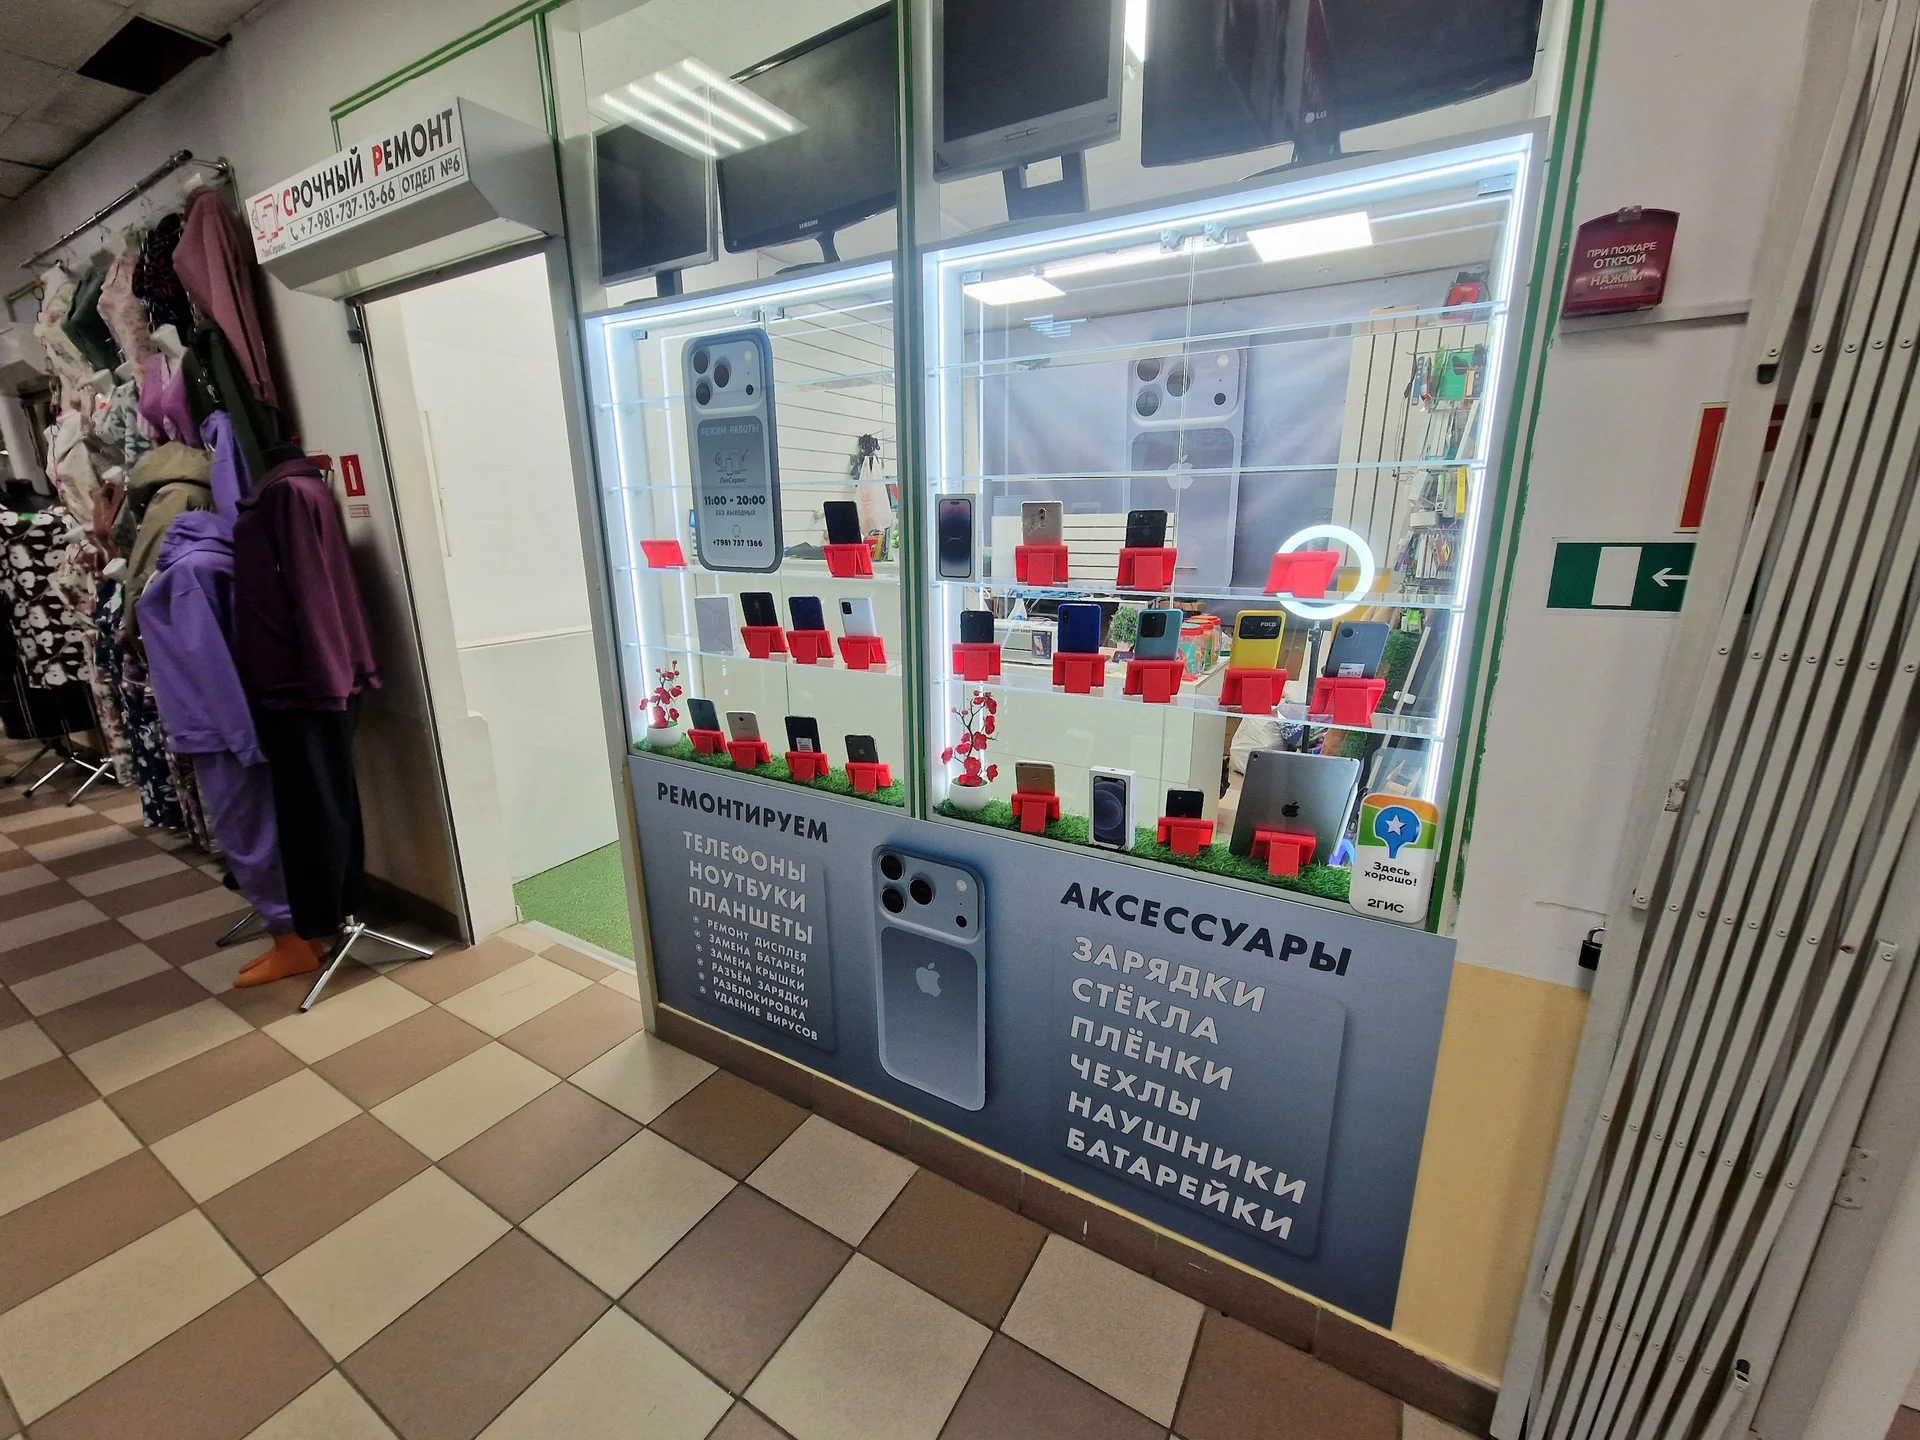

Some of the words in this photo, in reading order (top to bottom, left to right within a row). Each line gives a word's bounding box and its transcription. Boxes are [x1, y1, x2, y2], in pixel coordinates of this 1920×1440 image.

[282, 146, 364, 216] СРОЧНЫЙ
[371, 108, 453, 177] РЕМОНТ
[401, 165, 435, 194] ОТДЕЛ
[440, 154, 460, 178] №6
[1587, 249, 1608, 258] ПРИ
[1610, 241, 1658, 255] ПОЖАРЕ
[1593, 252, 1647, 269] ОТКРОЙ
[1590, 269, 1646, 286] НАЖМИ
[700, 426, 727, 436] РЕЖИМ
[729, 423, 759, 435] РАБОТЫ
[704, 495, 727, 506] 11:00
[736, 495, 766, 506] 20:00
[726, 509, 756, 517] ВЫХОДНЫХ
[712, 539, 731, 547] +7981
[657, 782, 828, 843] РЕМОНТИРУЕМ
[682, 830, 806, 883] ТЕЛЕФОНЫ
[1364, 870, 1418, 887] хорошо!
[1373, 861, 1411, 876] Здесь
[689, 860, 806, 913] НОУТБУКИ
[1367, 898, 1405, 914] 2ГИС
[688, 886, 813, 945] ПЛАНШЕТЫ
[1060, 882, 1352, 977] АКСЕССУАРЫ
[707, 919, 749, 942] РЕМОНТ
[754, 936, 807, 963] ДИСПЛЕЯ
[709, 933, 751, 957] ЗАМЕНА
[757, 951, 805, 977] БАТАРЕИ
[710, 948, 752, 972] ЗАМЕНА
[755, 965, 805, 992] КРЫШКИ
[712, 962, 752, 985] РАЗЪЁМ
[757, 980, 809, 1009] ЗАРЯДКИ
[1071, 936, 1266, 1013] ЗАРЯДКИ
[713, 976, 806, 1022] РАЗБЛОКИРОВКА
[714, 990, 761, 1017] УДАЕНИЕ
[766, 1012, 818, 1041] ВИРУСОВ
[1071, 977, 1220, 1045] СТЁКЛА
[1070, 1015, 1233, 1091] ПЛЁНКИ
[1070, 1053, 1201, 1122] ЧЕХЛЫ
[1067, 1091, 1307, 1204] НАУШНИКИ
[1066, 1127, 1293, 1241] БАТАРЕЙКИ
